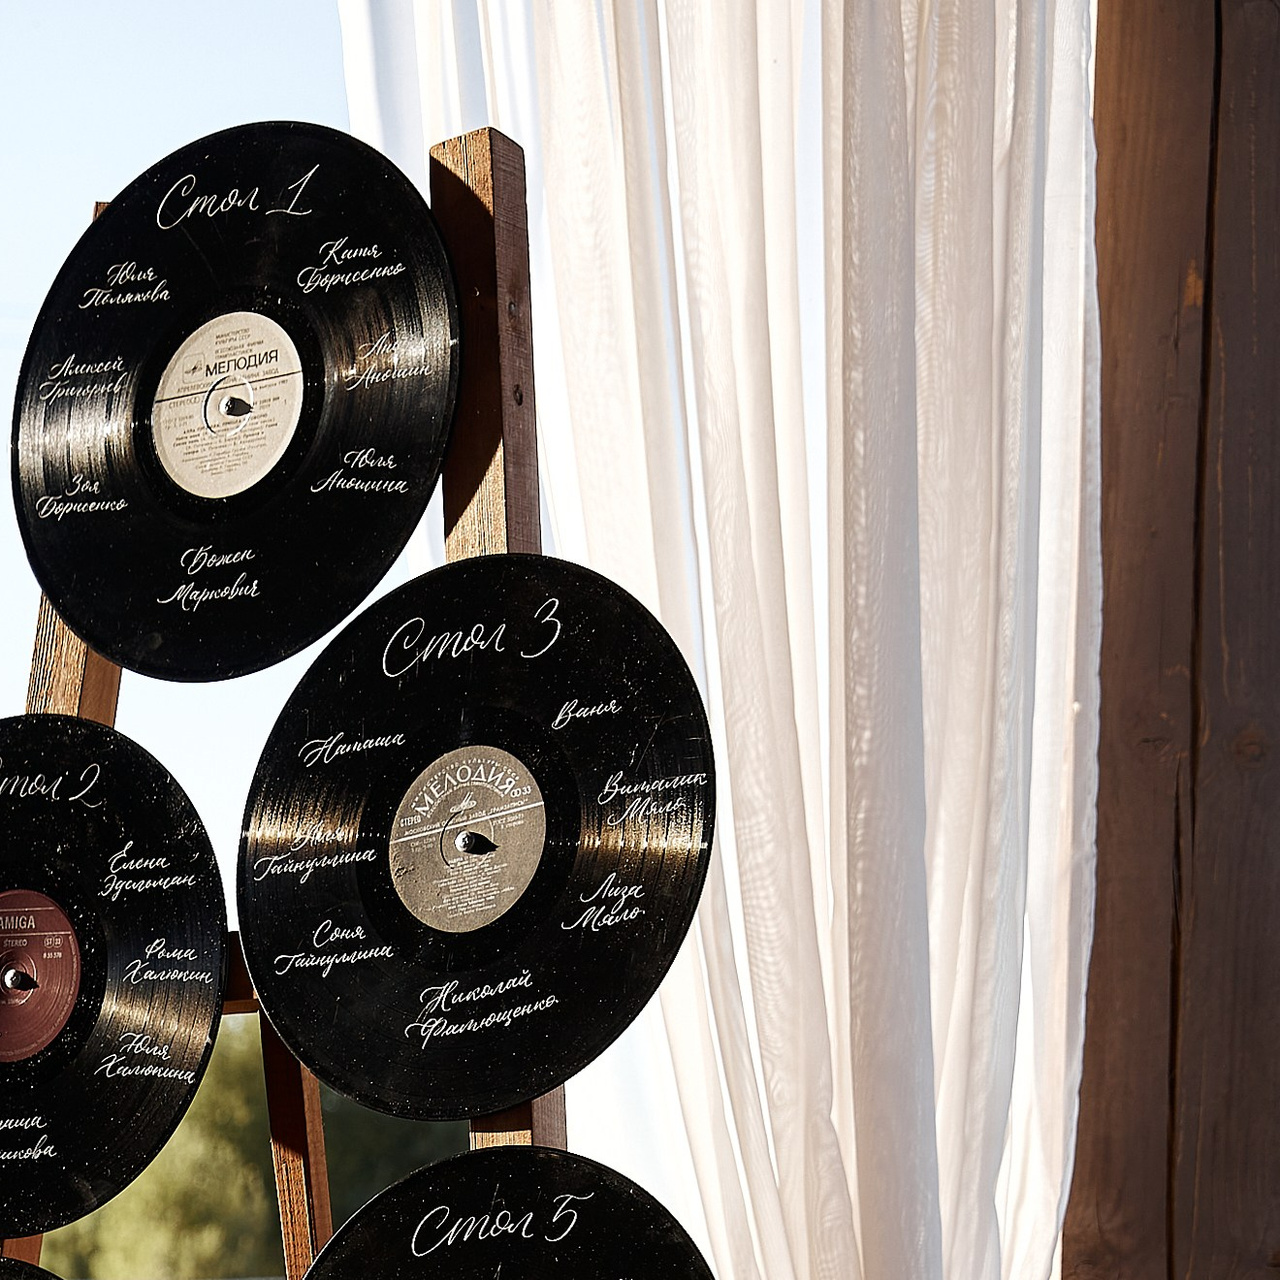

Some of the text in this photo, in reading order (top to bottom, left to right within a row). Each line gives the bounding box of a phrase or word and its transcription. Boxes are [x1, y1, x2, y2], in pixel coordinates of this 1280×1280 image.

[156, 164, 320, 230] Стол 1
[205, 349, 279, 377] МЕЛОДИЯ
[35, 495, 129, 521] Борисенко
[157, 571, 261, 612] Маркович
[382, 597, 562, 677] Стол 3
[551, 699, 622, 730] Ваня
[298, 732, 406, 767] Наташа
[69, 763, 106, 808] 2
[414, 763, 515, 817] МЕЛОДИЯ
[598, 770, 708, 805] Виталик
[108, 840, 170, 874] Елена
[253, 849, 377, 884] Гайнуллина
[579, 872, 645, 914] Лиза
[312, 919, 367, 949] Соня
[420, 969, 534, 1013] Николай
[119, 1031, 171, 1060] Юля
[411, 1192, 594, 1256] Стол 5
